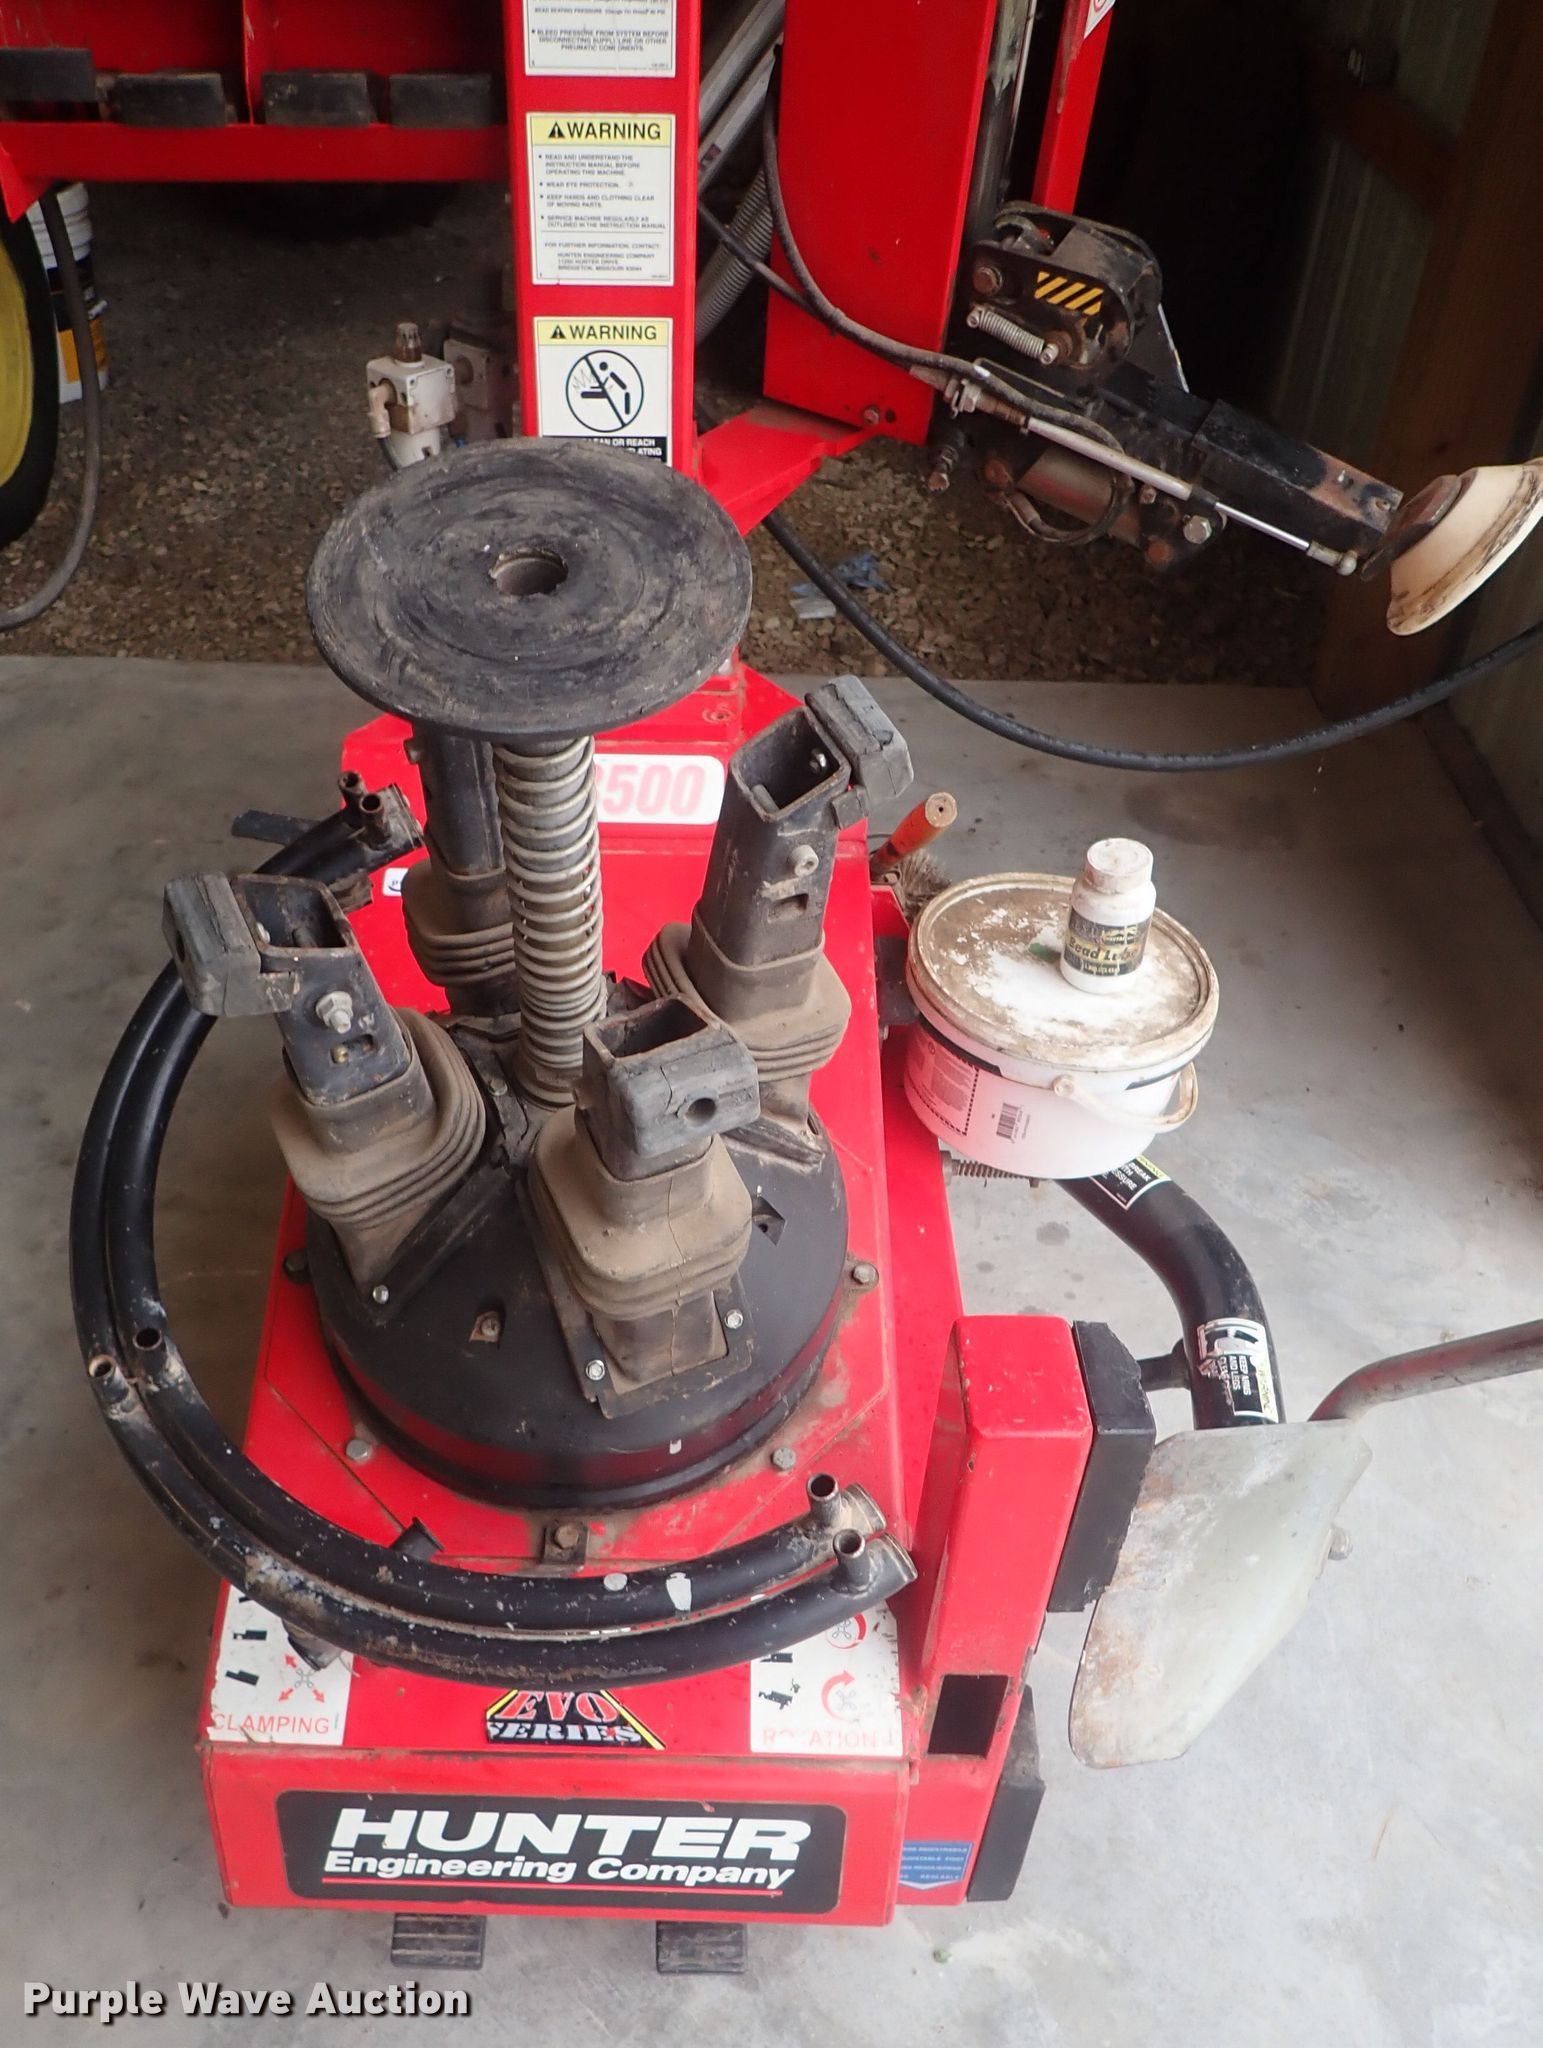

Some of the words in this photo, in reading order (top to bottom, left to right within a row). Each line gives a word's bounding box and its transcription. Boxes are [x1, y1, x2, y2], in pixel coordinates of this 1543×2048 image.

[567, 122, 661, 139] WARNING
[570, 325, 657, 340] WARNING
[612, 438, 625, 447] OR
[626, 439, 655, 447] REACH
[493, 1691, 619, 1723] EVO
[213, 1713, 330, 1735] CLAMPING
[486, 1721, 642, 1743] SERIES
[330, 1807, 812, 1861] HUNTER
[324, 1850, 576, 1886] Engineering
[586, 1856, 795, 1889] Company
